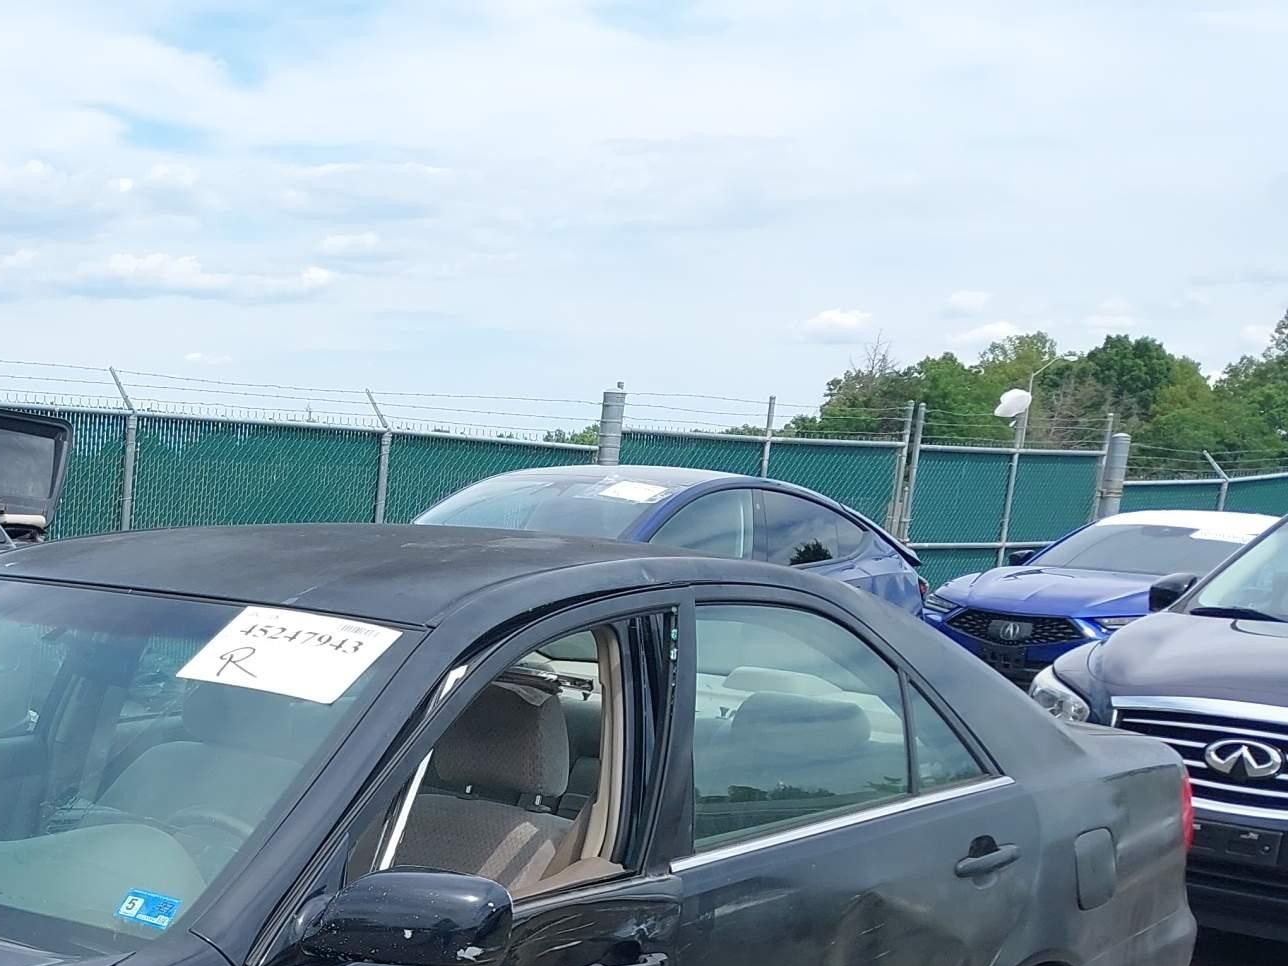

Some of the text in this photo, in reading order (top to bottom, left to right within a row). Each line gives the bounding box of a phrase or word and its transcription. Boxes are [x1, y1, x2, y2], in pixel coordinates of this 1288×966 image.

[240, 624, 364, 654] 45247943
[216, 646, 257, 678] R
[125, 898, 139, 911] 5
